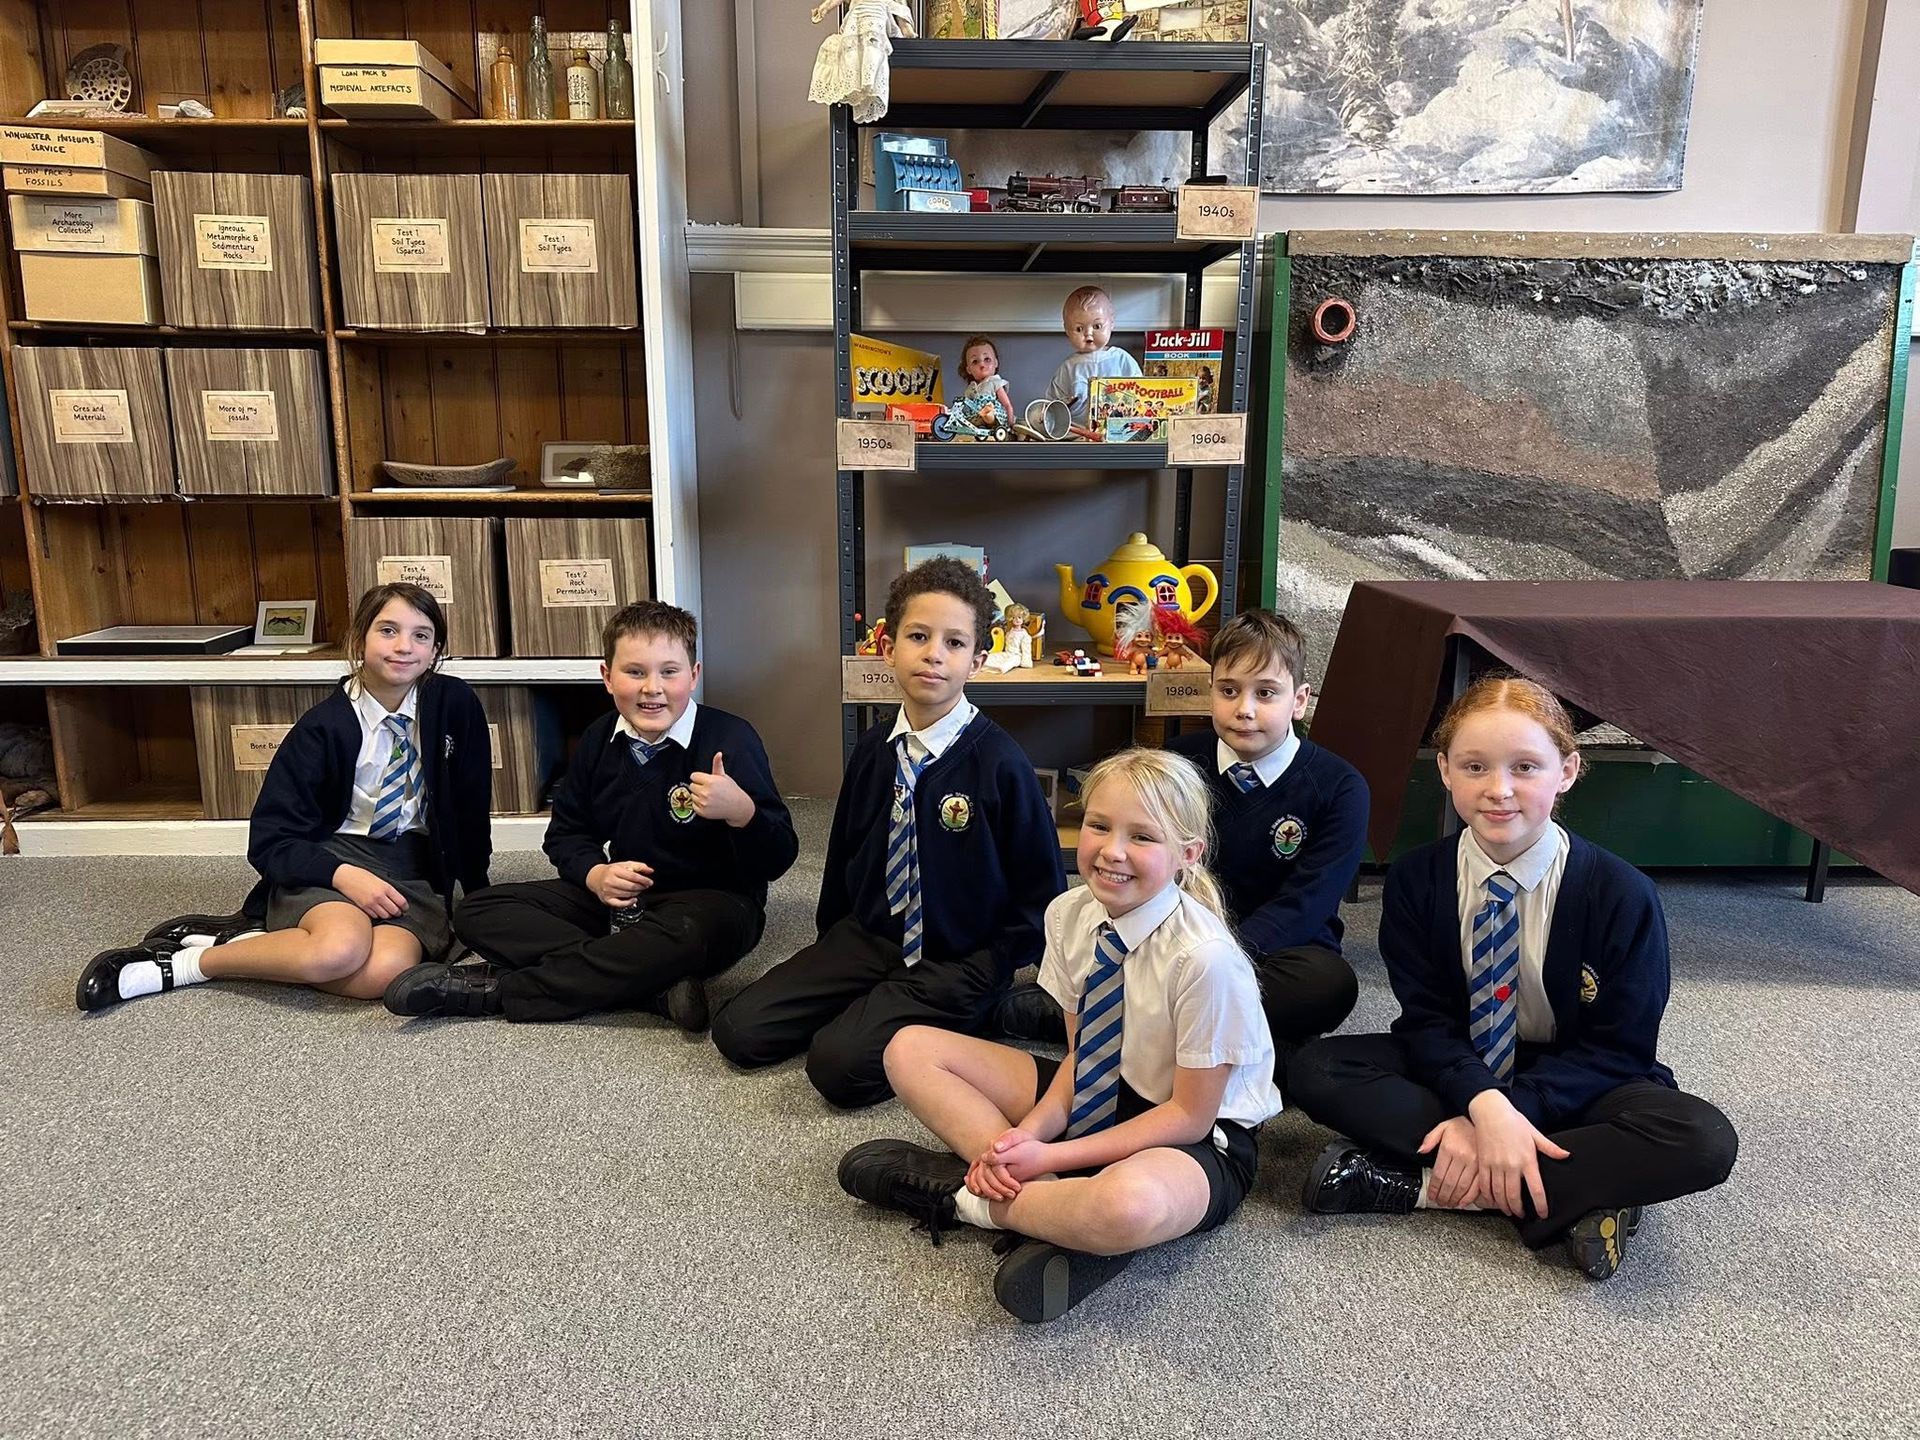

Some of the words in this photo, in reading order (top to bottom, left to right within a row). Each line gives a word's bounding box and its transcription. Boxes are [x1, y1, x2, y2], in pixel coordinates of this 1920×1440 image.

[330, 84, 367, 92] MEDIEVAL
[370, 85, 412, 93] ARTEFACTS
[4, 130, 51, 141] WINCHESTER
[57, 133, 95, 144] MUSEUMS
[31, 143, 66, 153] SERVICE
[17, 167, 39, 175] LOAN
[44, 168, 62, 176] PACK
[25, 177, 63, 186] FOSSILS
[1198, 205, 1235, 217] 1940s
[52, 219, 94, 229] Archaeology
[58, 226, 92, 234] Collection
[206, 233, 251, 243] Metamorphic
[391, 237, 404, 245] Soil
[405, 238, 426, 248] Types
[212, 242, 255, 253] Sedimentary
[396, 247, 425, 256] (Spares)
[552, 244, 572, 254] Types
[1151, 332, 1184, 347] Jack
[1187, 332, 1210, 347] Jill
[855, 363, 939, 402] SCOOP!
[1104, 381, 1137, 394] BLOW
[1135, 384, 1184, 399] FOOTBALL
[228, 414, 249, 422] fossils
[857, 438, 892, 449] 1950s
[1191, 433, 1226, 445] 1960s
[400, 574, 430, 582] Everyday
[556, 588, 597, 596] Permeability
[862, 673, 895, 683] 1970s
[1166, 686, 1199, 696] 1980s
